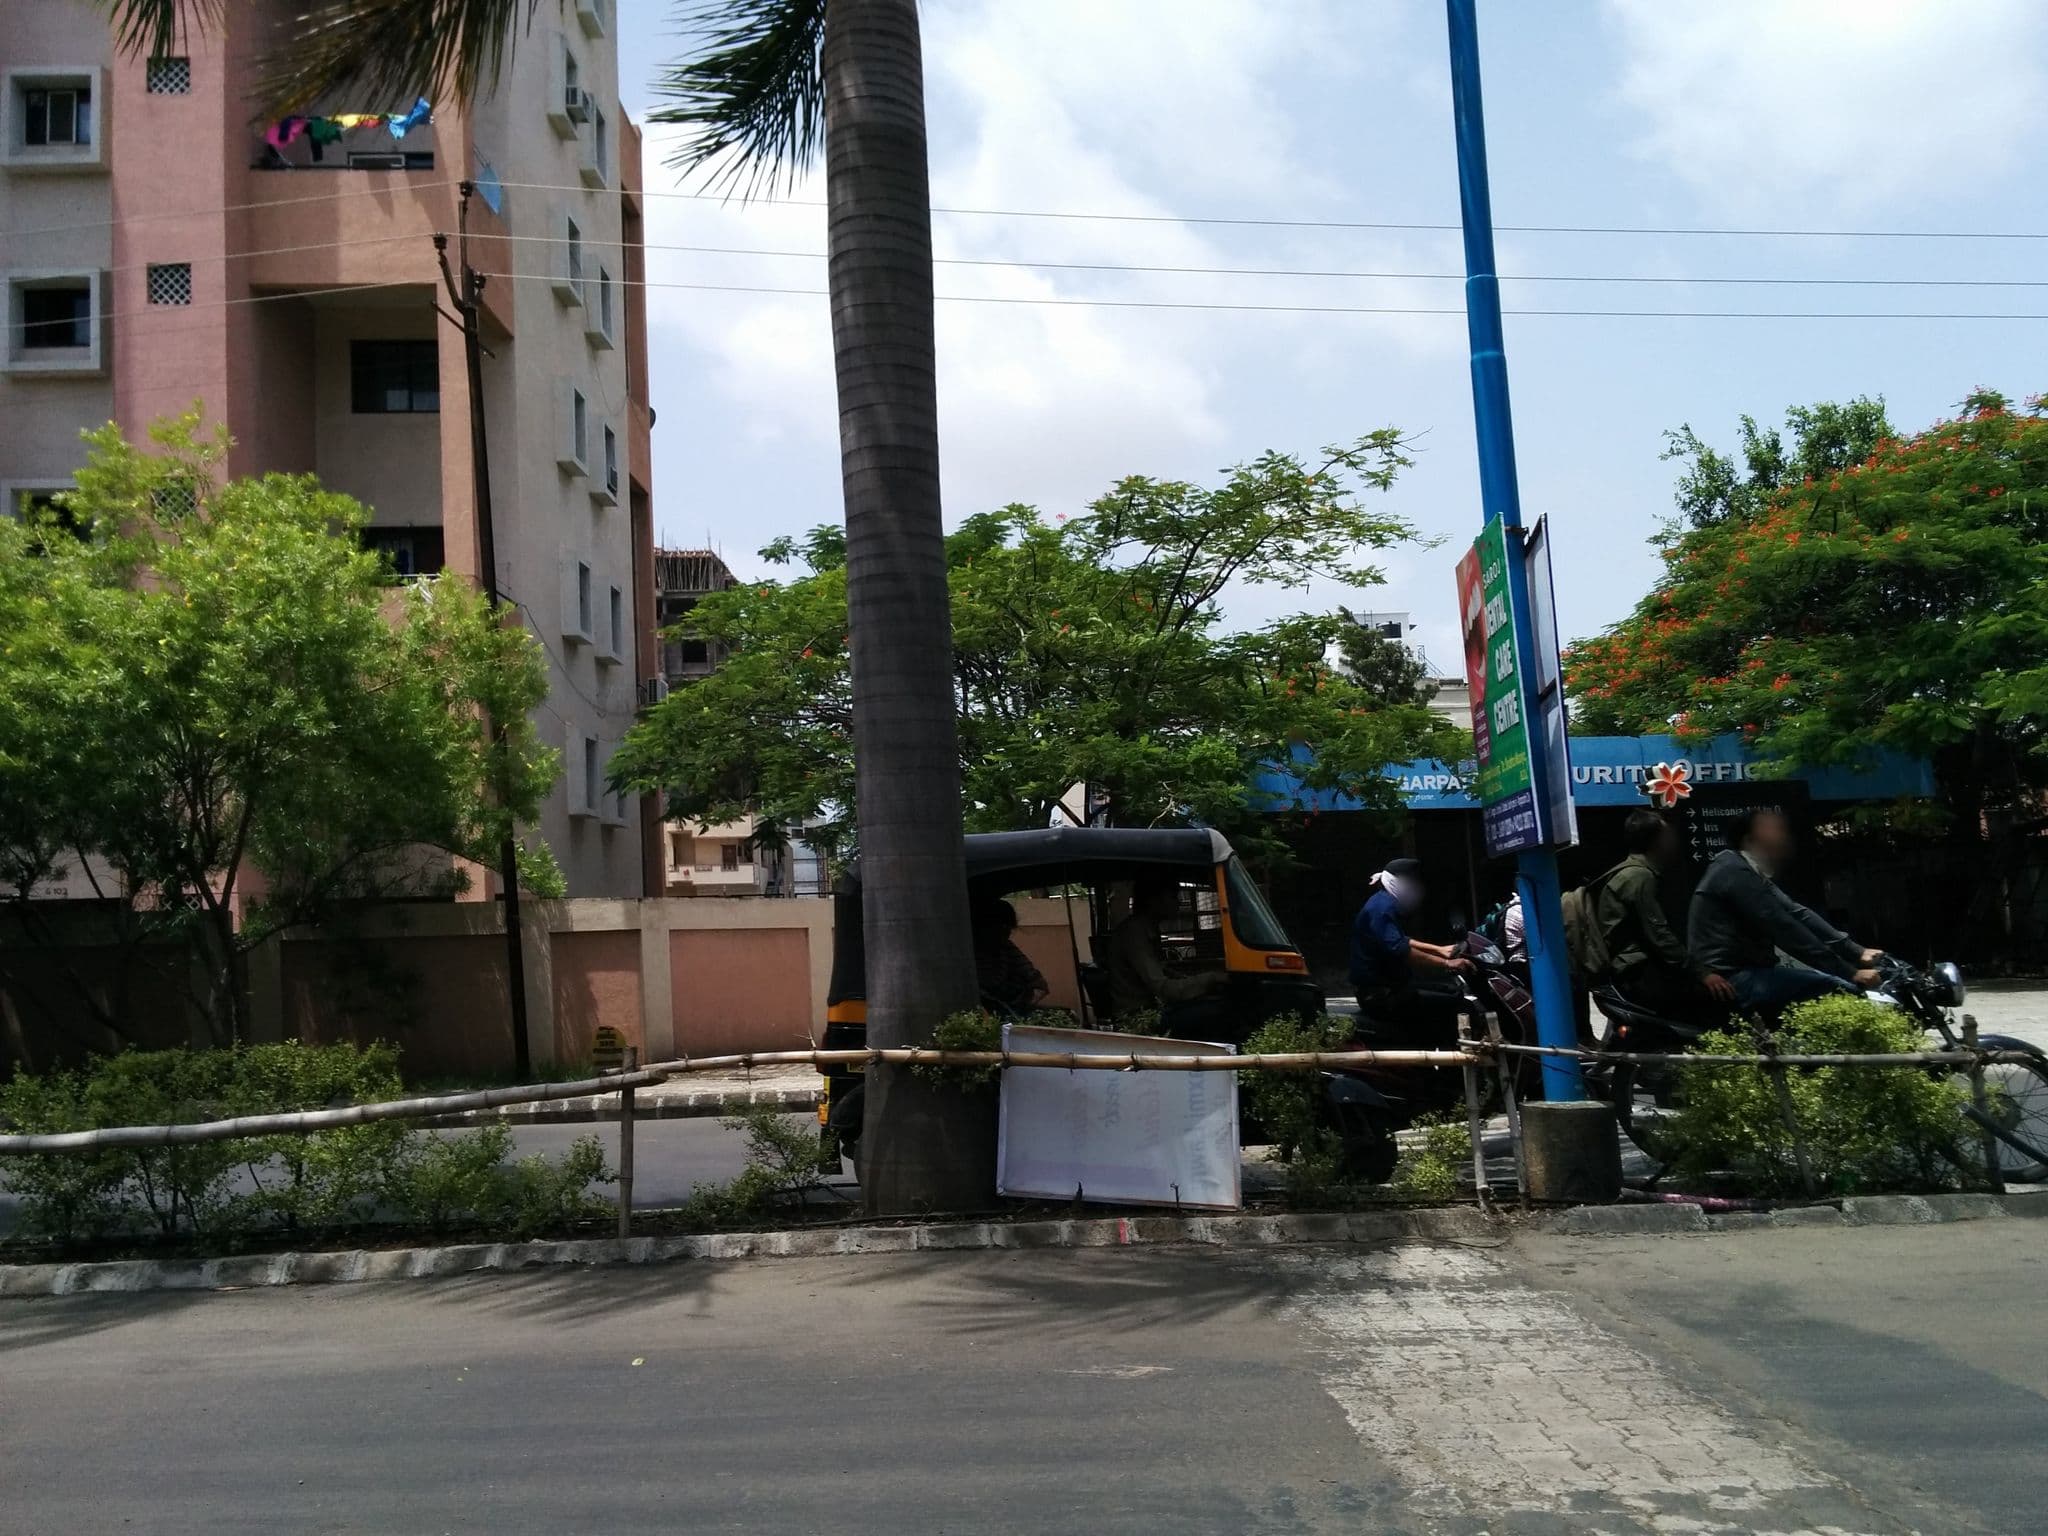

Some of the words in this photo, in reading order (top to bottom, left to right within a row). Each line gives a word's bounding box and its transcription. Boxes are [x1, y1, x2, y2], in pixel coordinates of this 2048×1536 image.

[1495, 638, 1514, 683] CARE
[1493, 688, 1520, 736] CENTRE
[1572, 764, 1650, 785] URIT
[1672, 758, 1757, 784] OFFIC
